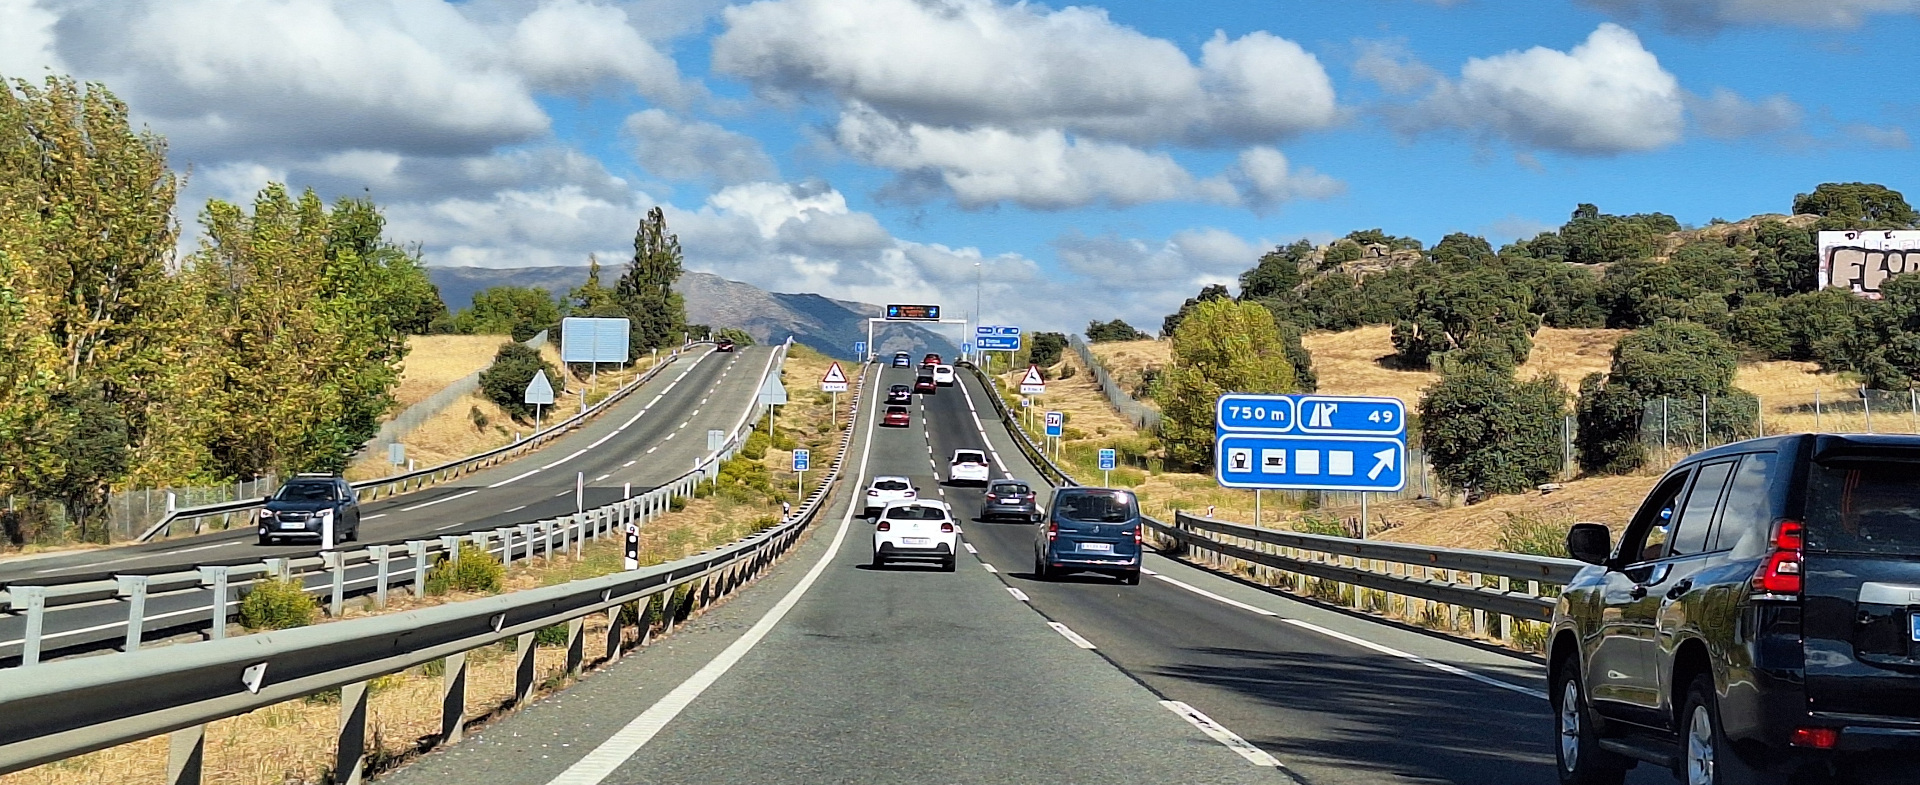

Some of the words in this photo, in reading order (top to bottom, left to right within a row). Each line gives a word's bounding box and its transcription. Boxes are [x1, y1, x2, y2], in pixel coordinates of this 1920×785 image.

[1229, 406, 1266, 420] 750
[1271, 410, 1285, 421] m
[1368, 410, 1393, 423] 49
